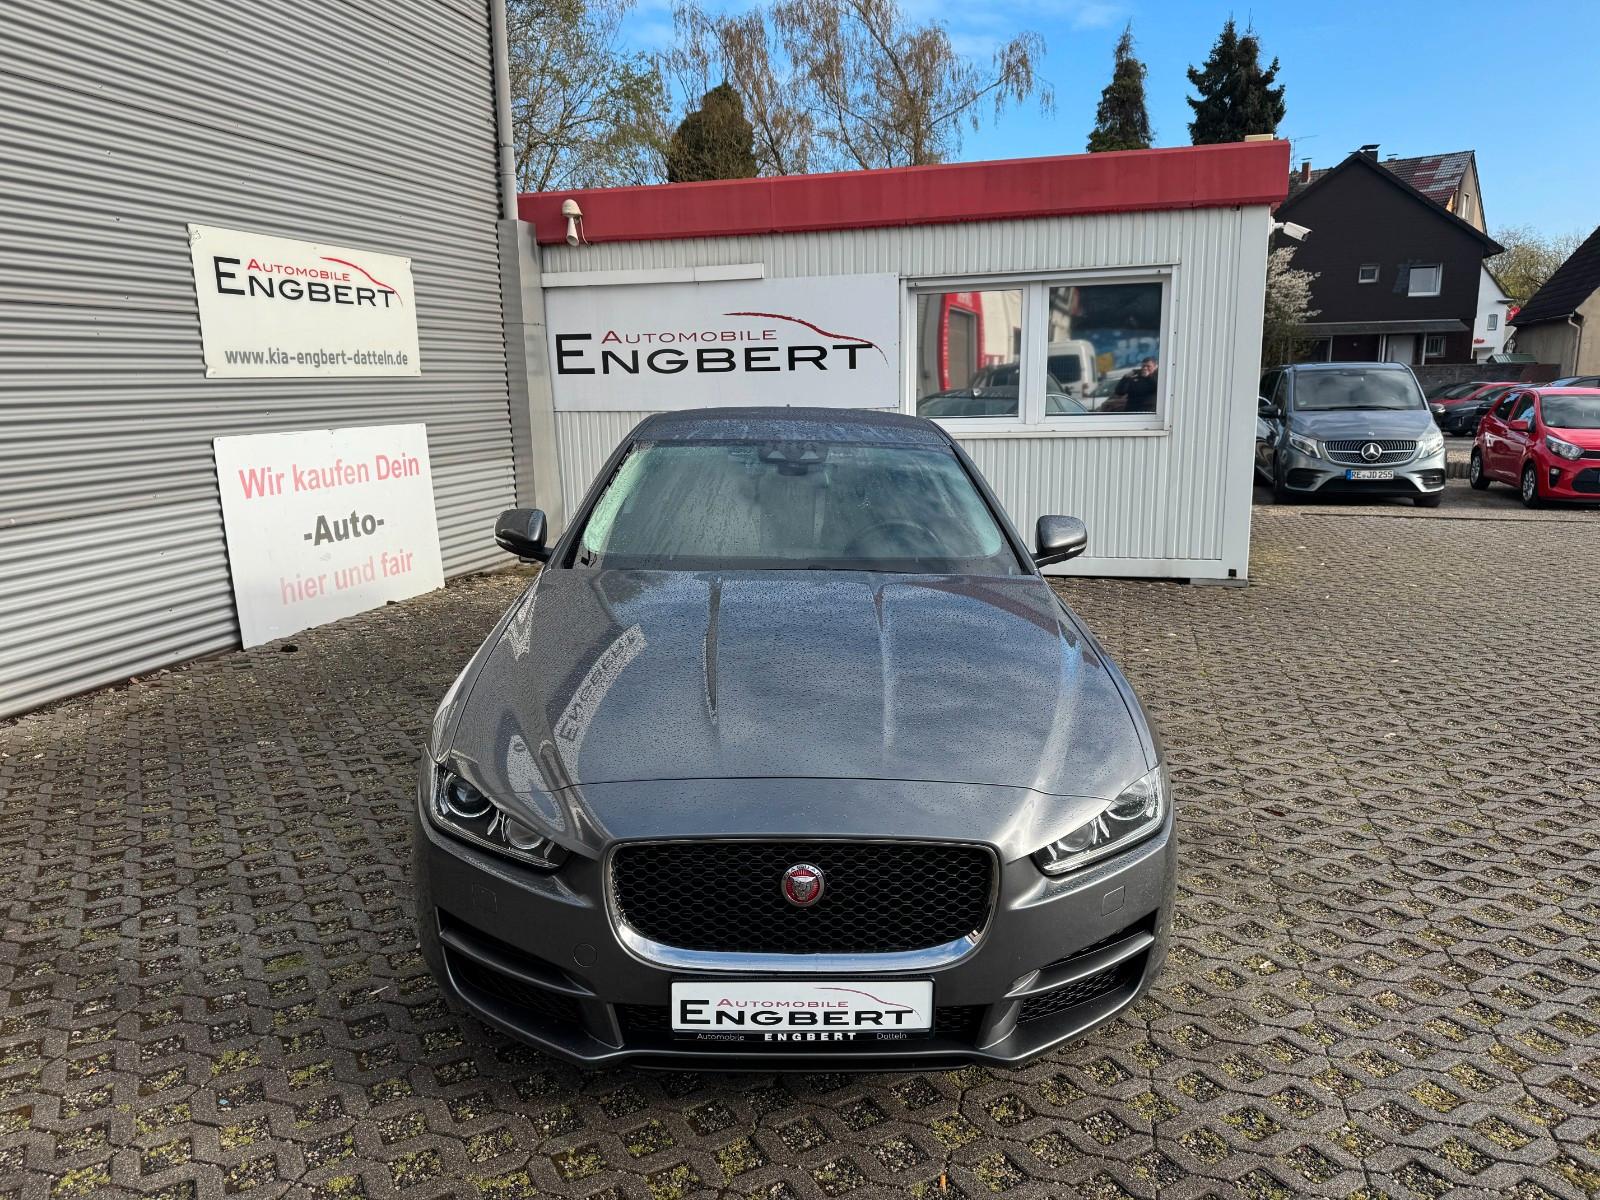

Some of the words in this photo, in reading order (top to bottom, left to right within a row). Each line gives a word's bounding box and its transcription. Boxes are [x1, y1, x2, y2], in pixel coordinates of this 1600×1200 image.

[213, 256, 395, 308] ENGBERT
[247, 258, 350, 282] AUTOMOBILE
[601, 329, 778, 344] AUTOMOBILE
[224, 347, 409, 368] www.kia-engbert-datteln.de
[555, 333, 874, 375] ENGBERT
[238, 467, 285, 500] Wir
[292, 459, 370, 492] kaufen
[375, 452, 420, 481] Dein
[303, 510, 385, 546] -Auto-
[279, 573, 328, 606] hier
[335, 557, 376, 588] und
[381, 549, 413, 578] fair
[680, 1000, 913, 1025] ENGBERT
[717, 999, 849, 1008] AUTOMOBILE
[697, 1033, 745, 1041] Automobile
[764, 1032, 857, 1041] ENGBERT
[876, 1032, 907, 1040] Datteln
